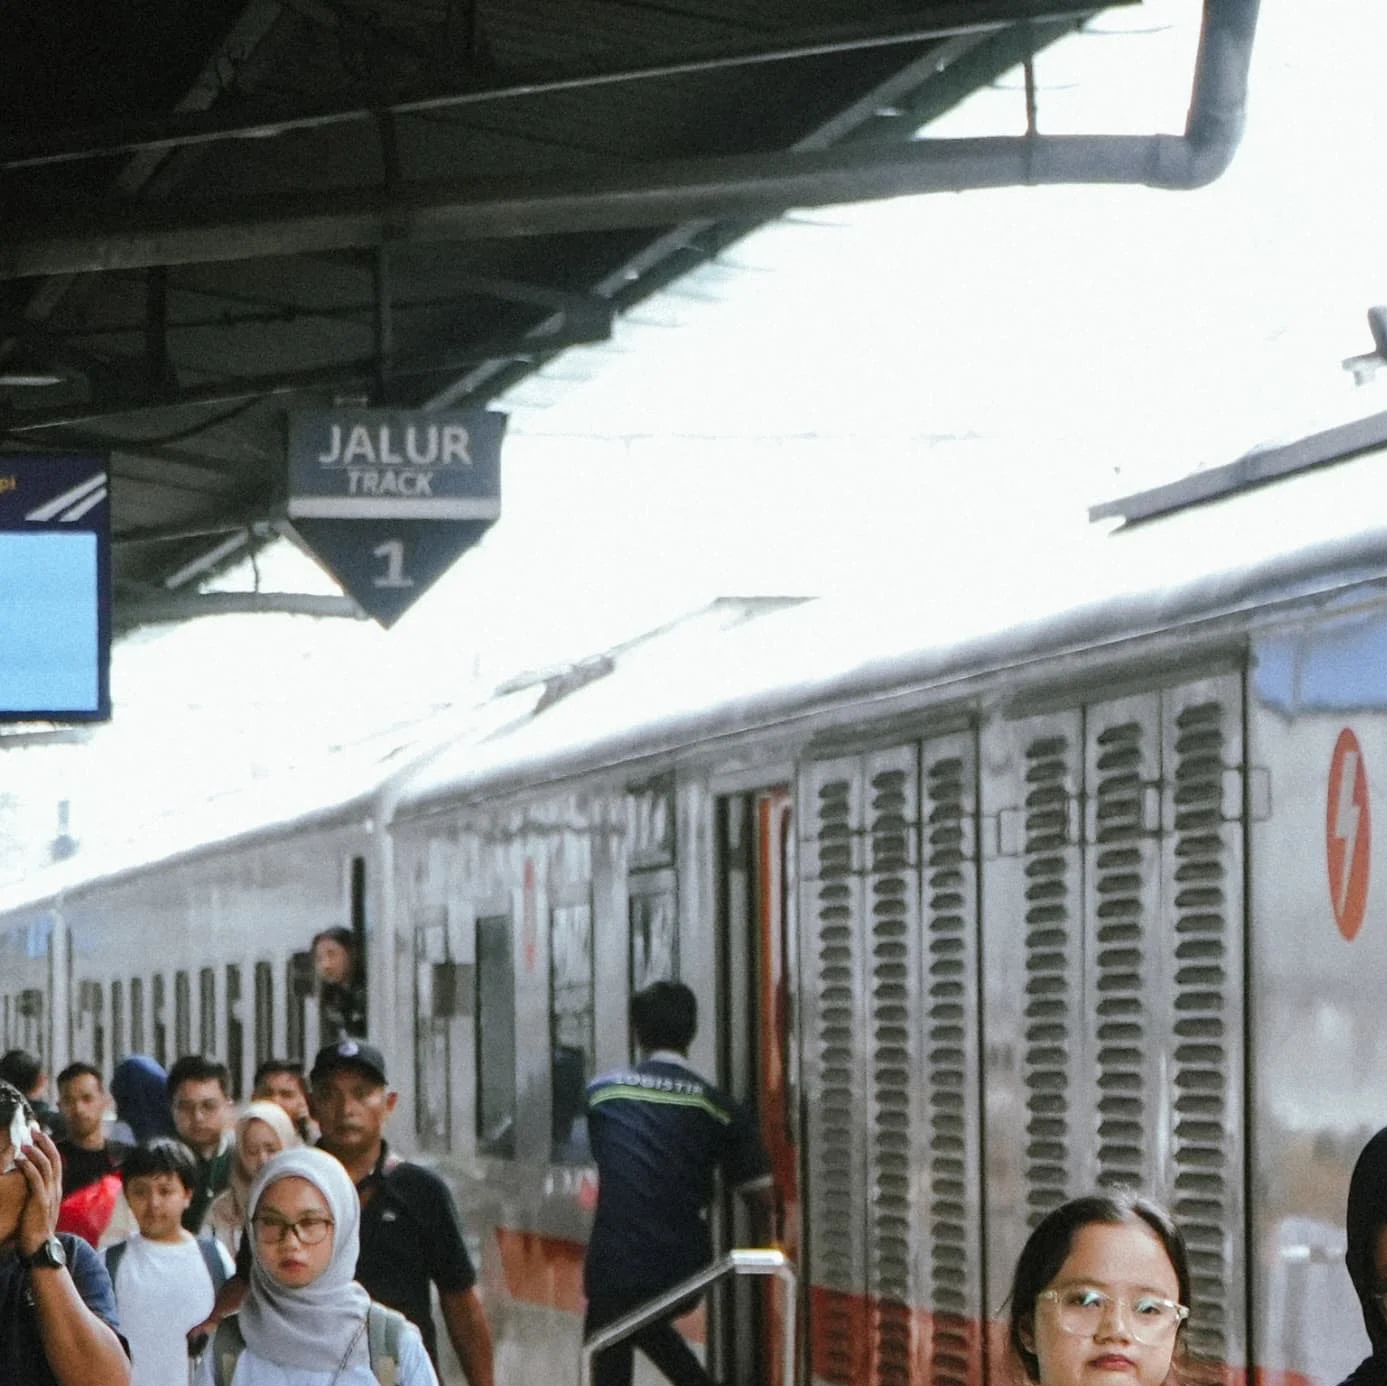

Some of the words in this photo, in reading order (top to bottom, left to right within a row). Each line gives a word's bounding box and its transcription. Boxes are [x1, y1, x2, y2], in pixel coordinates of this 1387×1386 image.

[318, 424, 473, 466] JALUR
[349, 470, 435, 496] TRACK
[371, 539, 415, 589] 1
